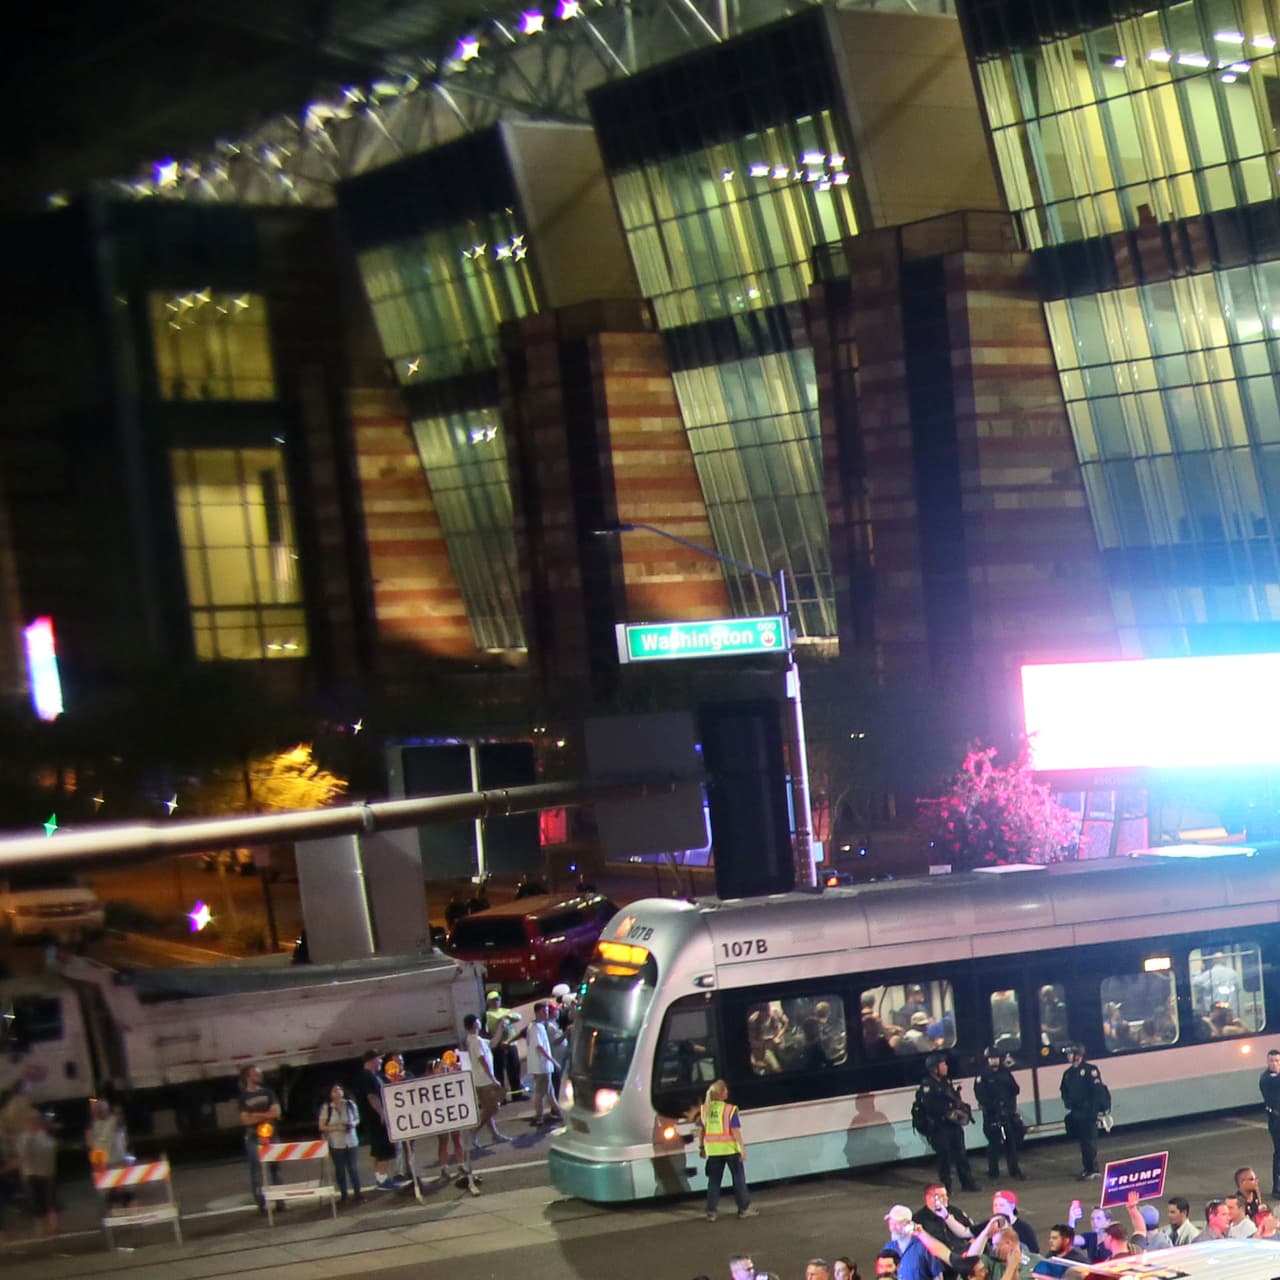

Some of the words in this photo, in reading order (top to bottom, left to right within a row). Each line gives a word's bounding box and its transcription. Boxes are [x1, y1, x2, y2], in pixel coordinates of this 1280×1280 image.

[641, 626, 753, 651] Washington
[721, 939, 768, 958] 107B
[393, 1079, 465, 1108] STREET
[396, 1103, 470, 1132] CLOSED
[1109, 1168, 1162, 1187] TRUMP
